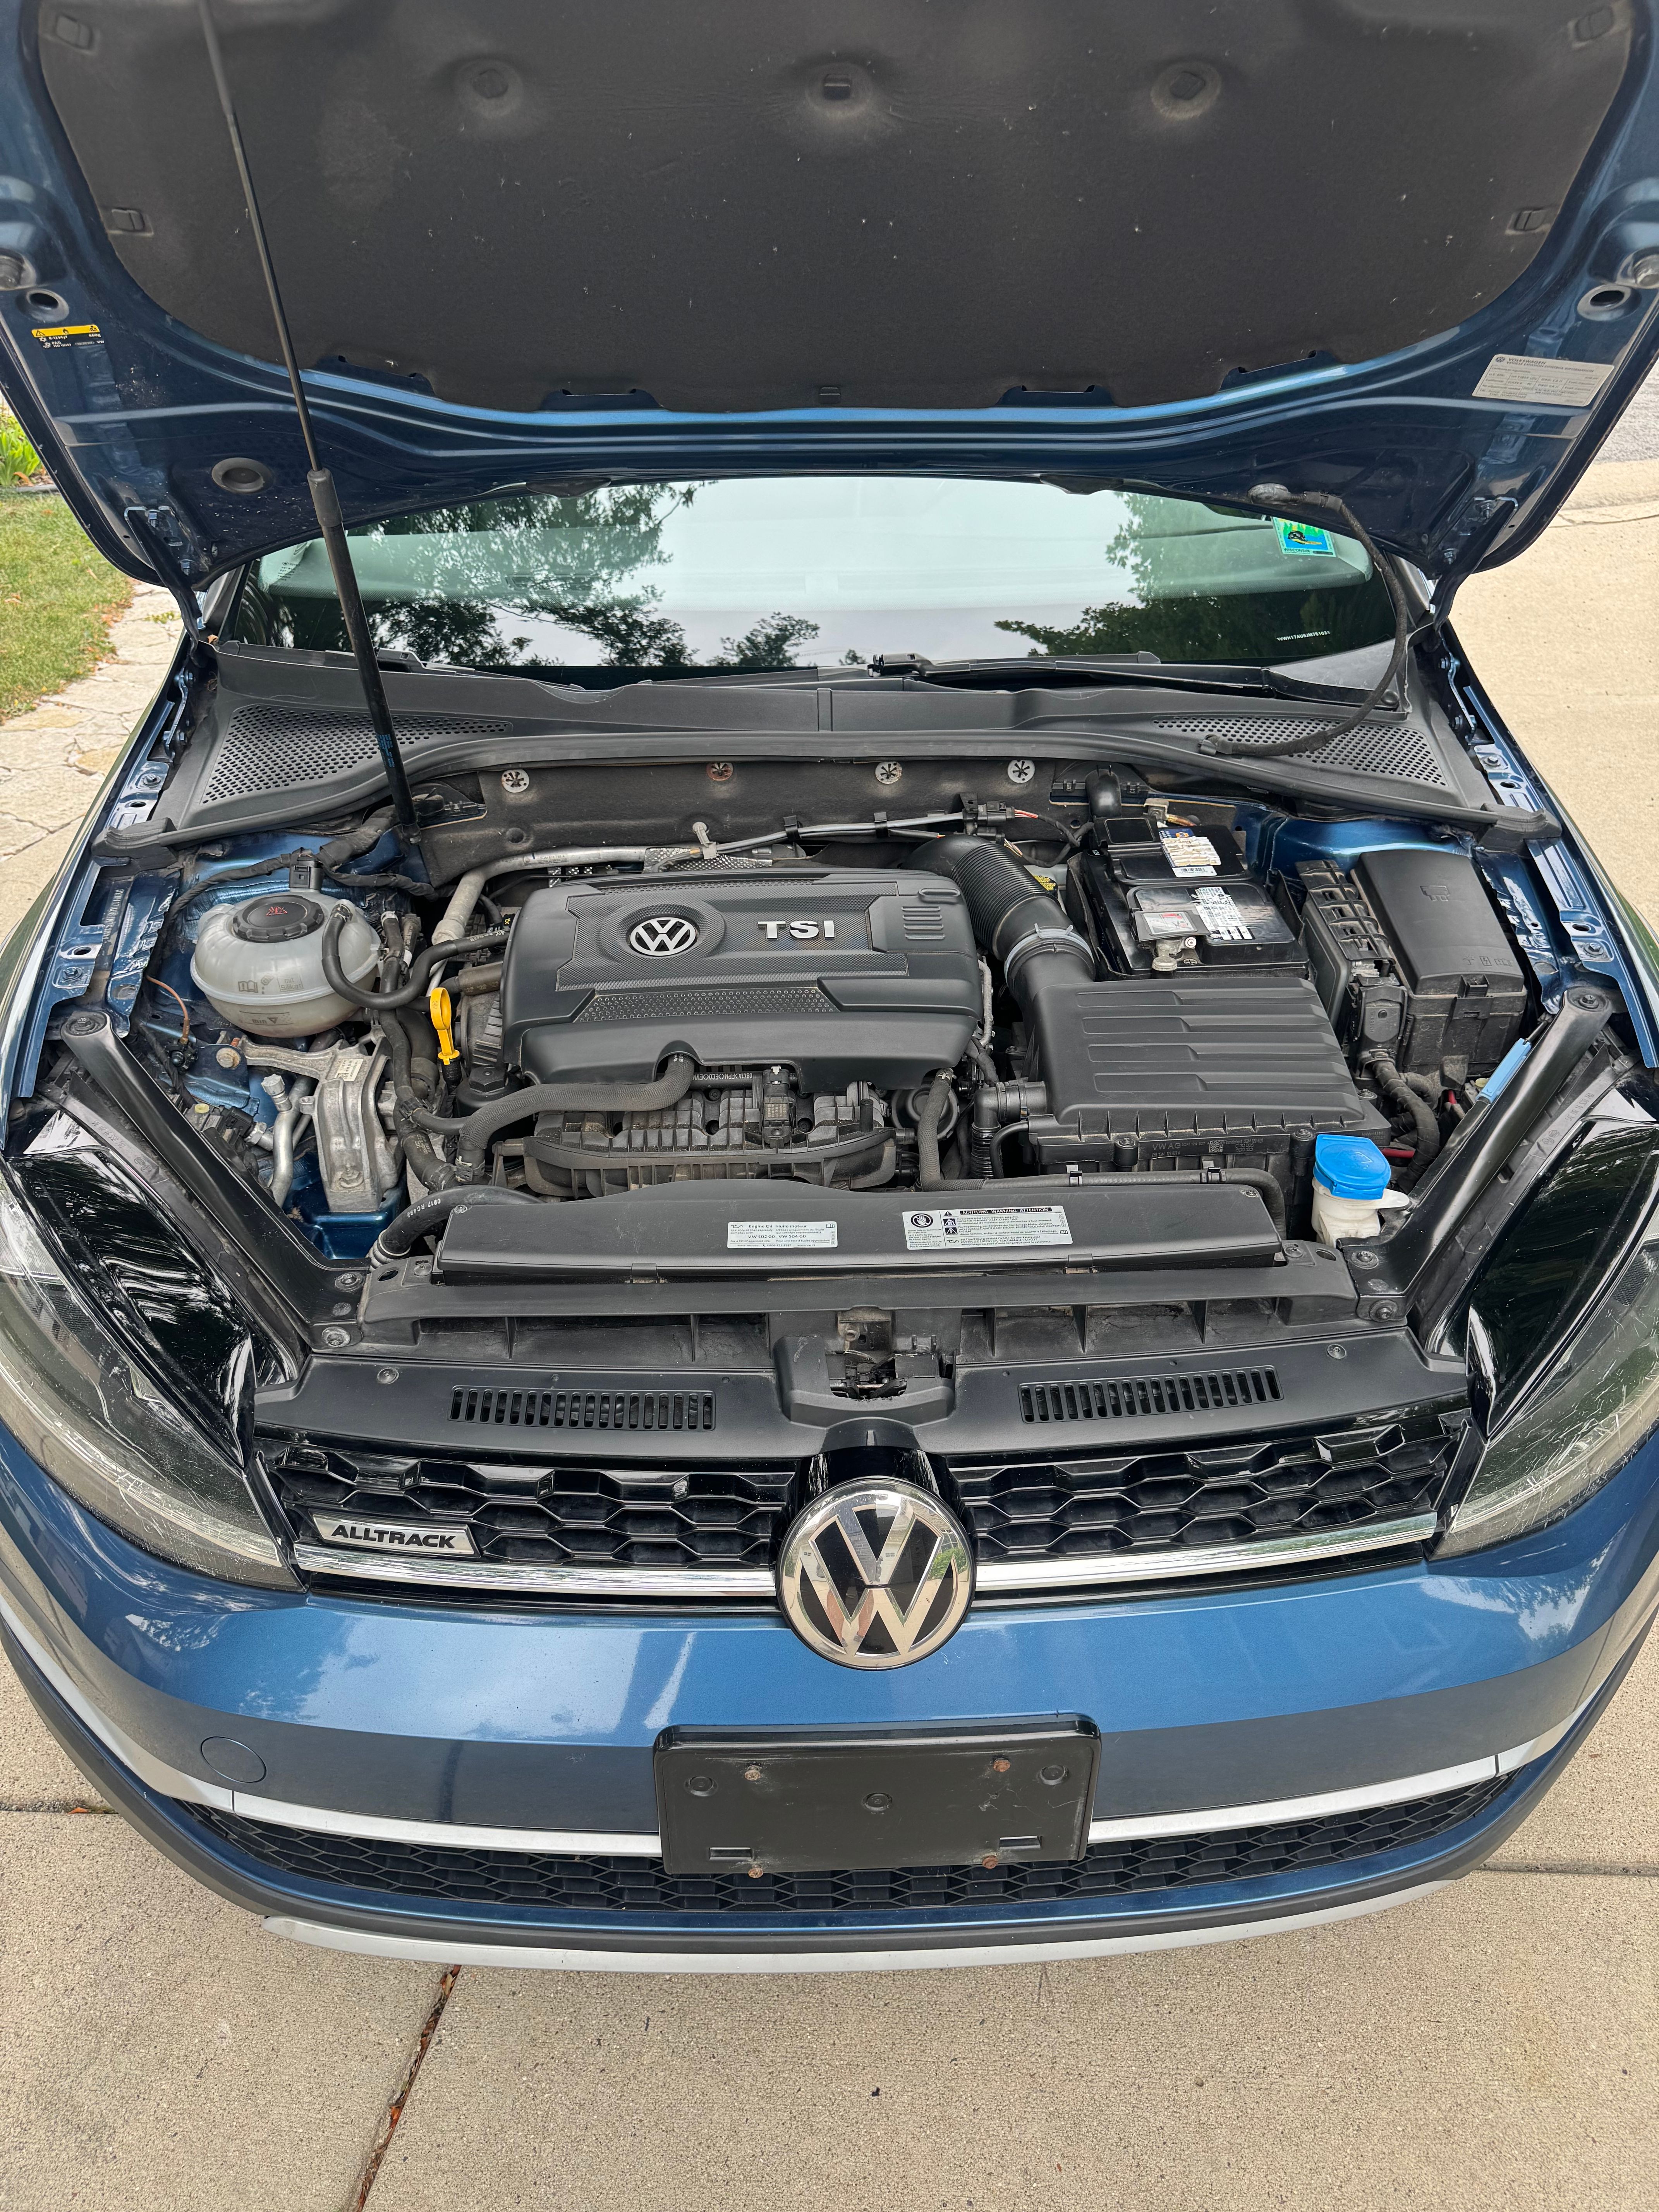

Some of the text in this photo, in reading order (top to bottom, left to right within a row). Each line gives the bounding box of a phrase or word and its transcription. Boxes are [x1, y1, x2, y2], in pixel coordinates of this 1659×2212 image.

[757, 920, 835, 940] TSI
[428, 1198, 441, 1207] 0917
[331, 1525, 456, 1549] ALLTRACK
